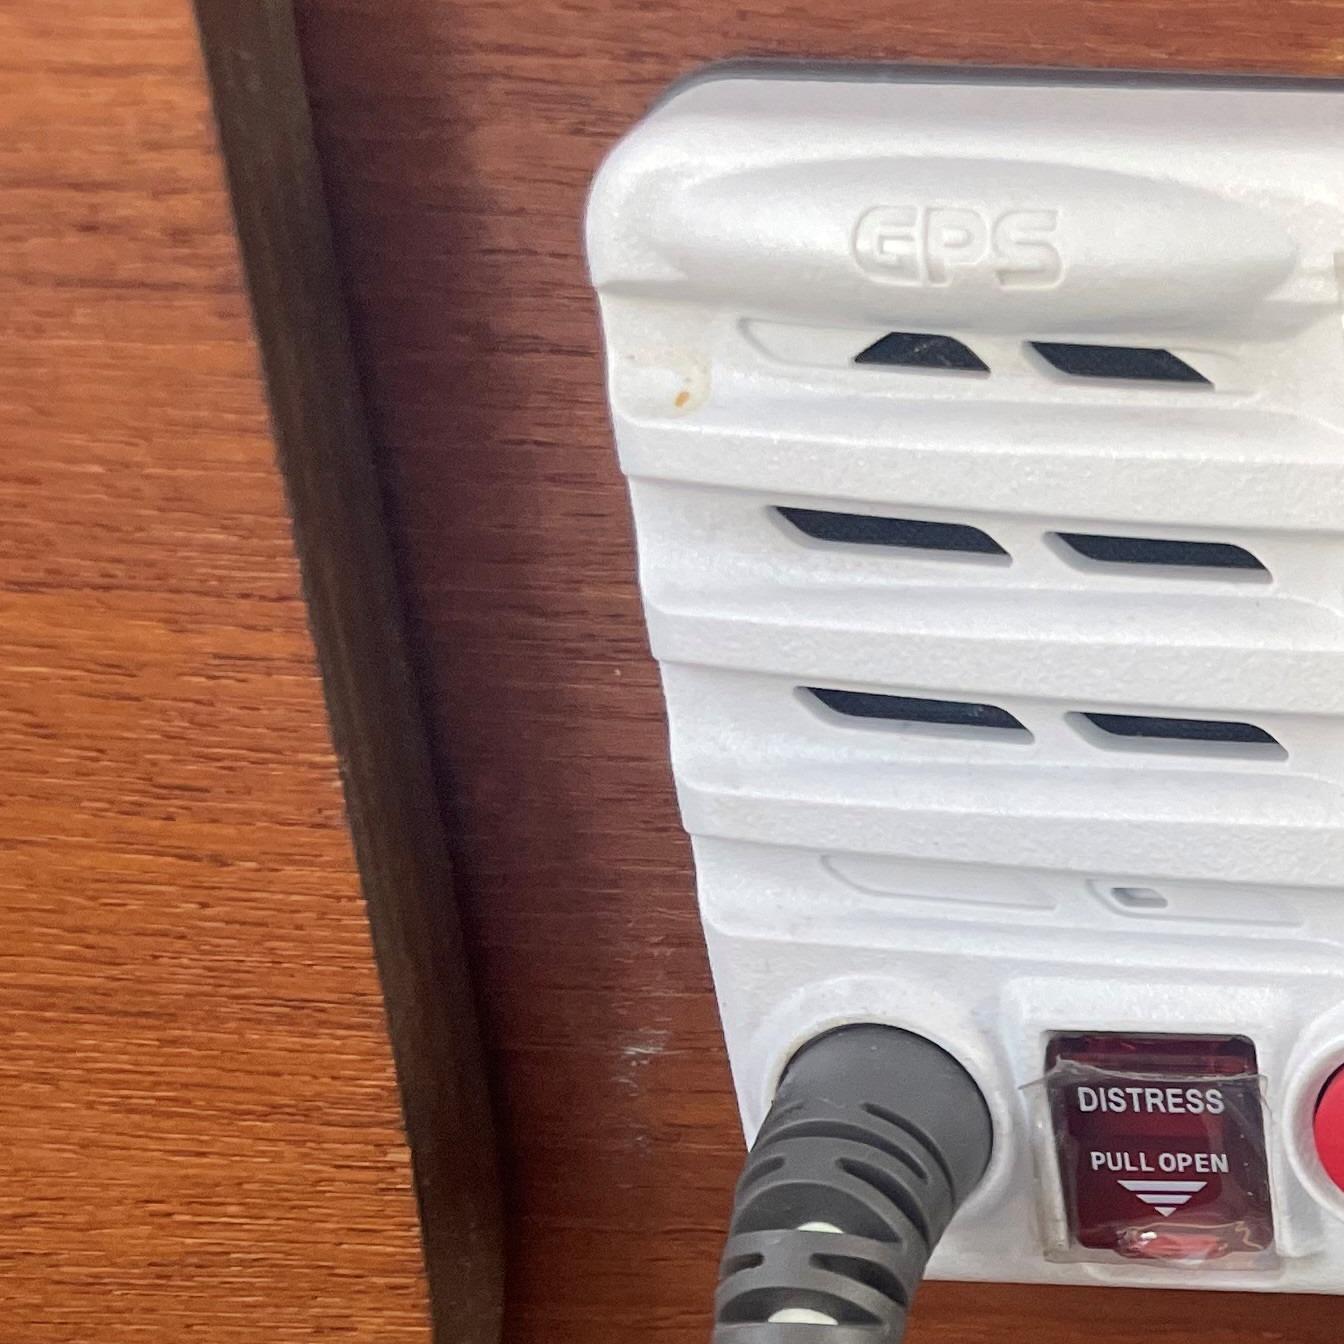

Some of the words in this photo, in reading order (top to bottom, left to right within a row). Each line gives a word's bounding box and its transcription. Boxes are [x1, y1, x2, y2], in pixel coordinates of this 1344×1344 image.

[850, 204, 1065, 289] GPS
[1077, 1086, 1225, 1115] DISTRESS
[1090, 1151, 1155, 1173] PULL
[1158, 1153, 1229, 1174] OPEN
